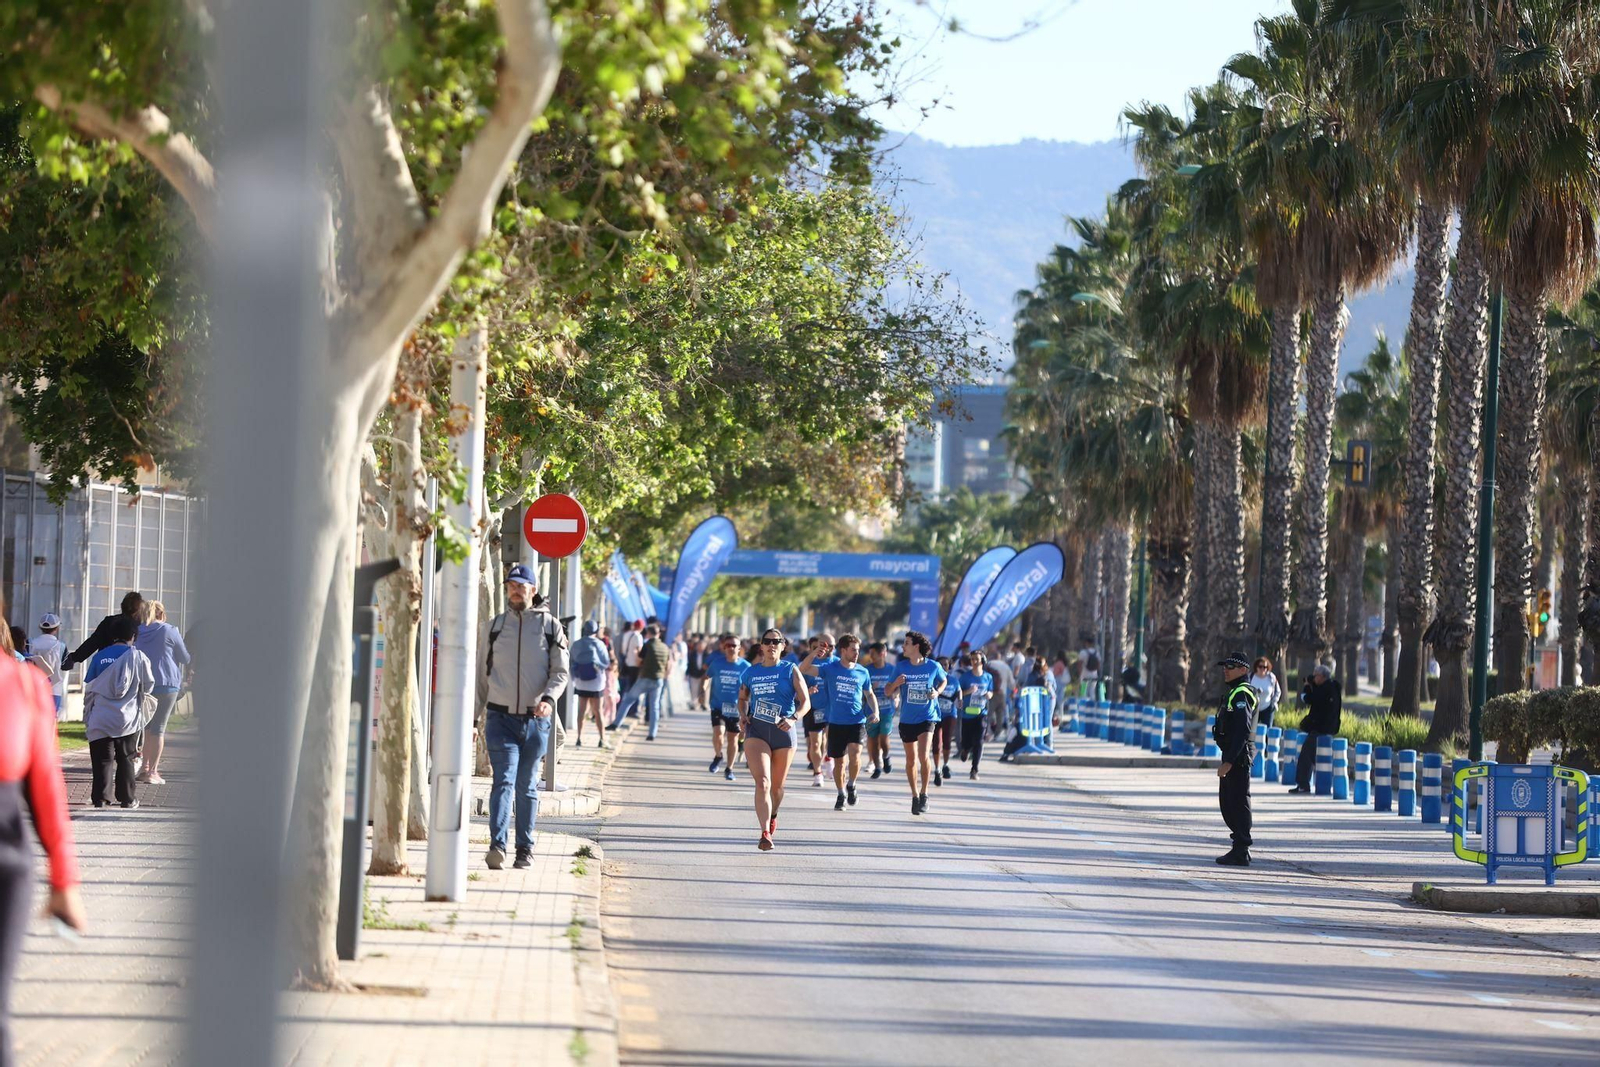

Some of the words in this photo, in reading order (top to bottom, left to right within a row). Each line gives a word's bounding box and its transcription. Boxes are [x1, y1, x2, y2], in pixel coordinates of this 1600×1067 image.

[677, 534, 725, 605] mayoral
[869, 558, 930, 575] mayoral
[983, 560, 1049, 626] mayoral
[751, 673, 780, 682] mayoral
